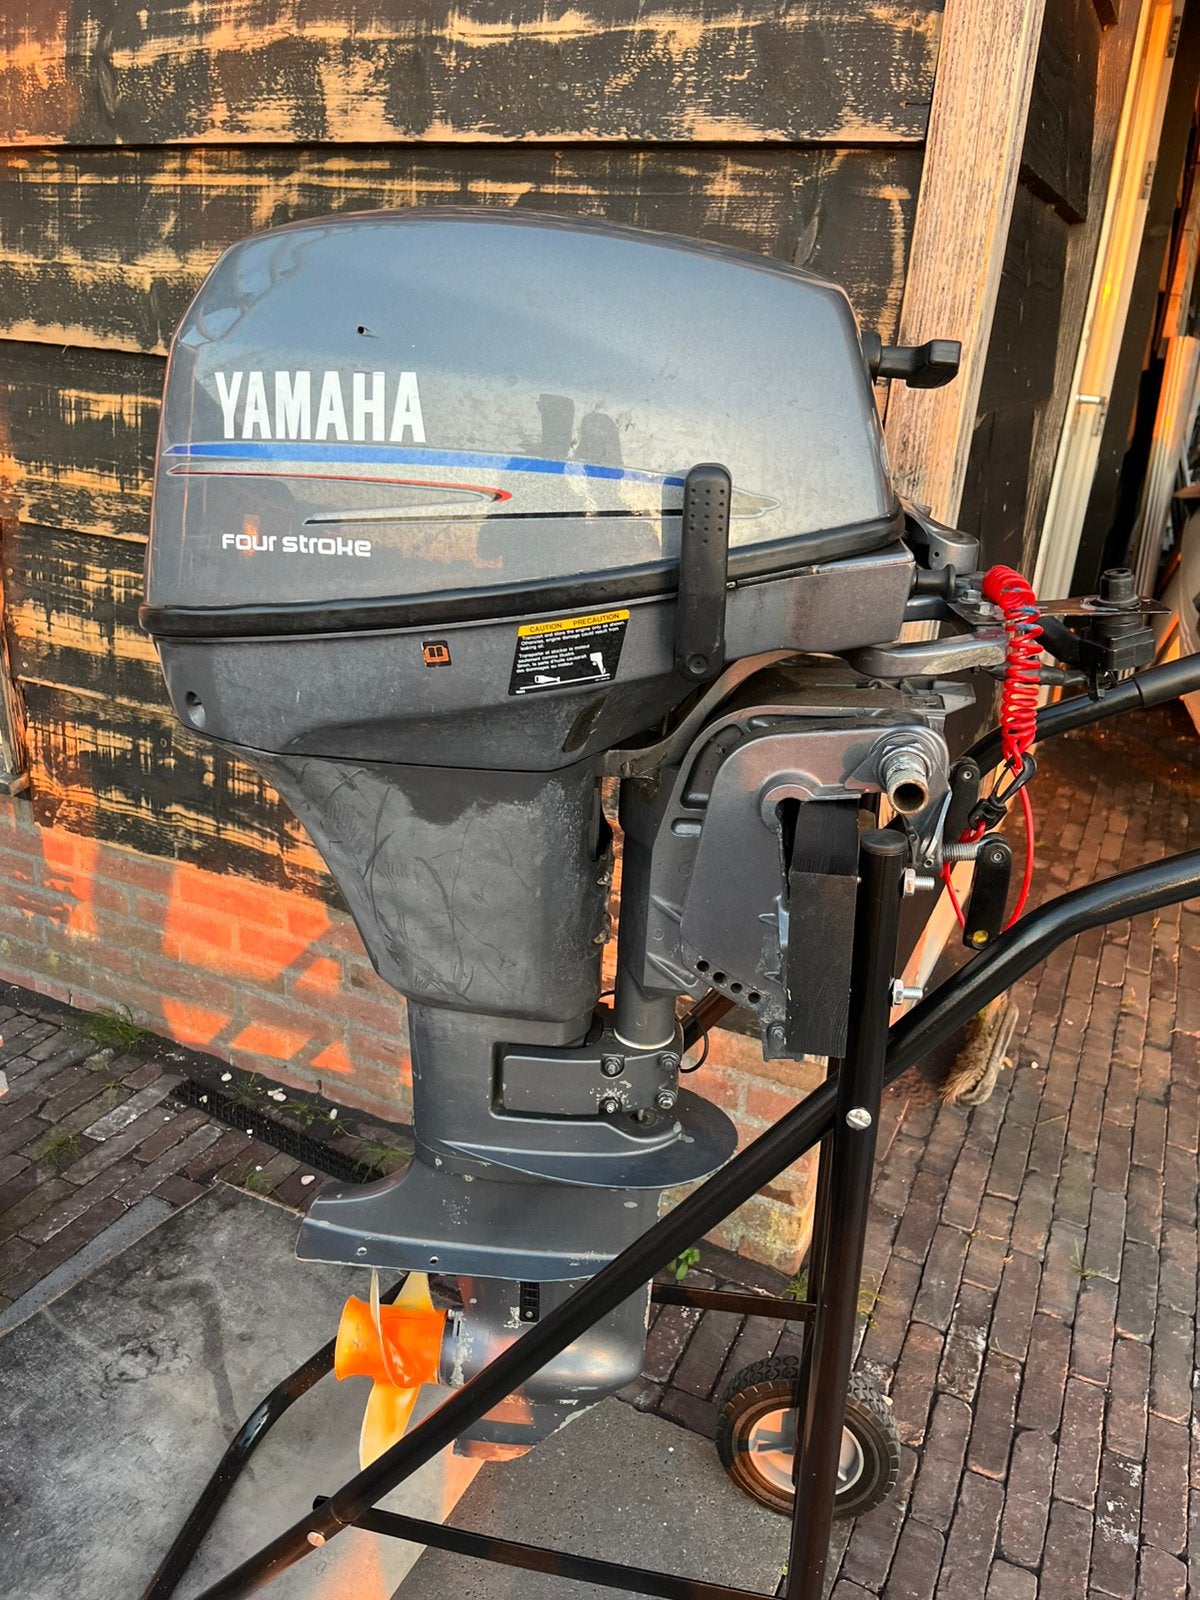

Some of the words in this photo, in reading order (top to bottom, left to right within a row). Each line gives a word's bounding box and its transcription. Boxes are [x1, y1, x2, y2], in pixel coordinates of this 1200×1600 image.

[214, 370, 426, 443] YAMAHA
[529, 623, 562, 633] CAUTION
[573, 613, 619, 626] PRECAUTION
